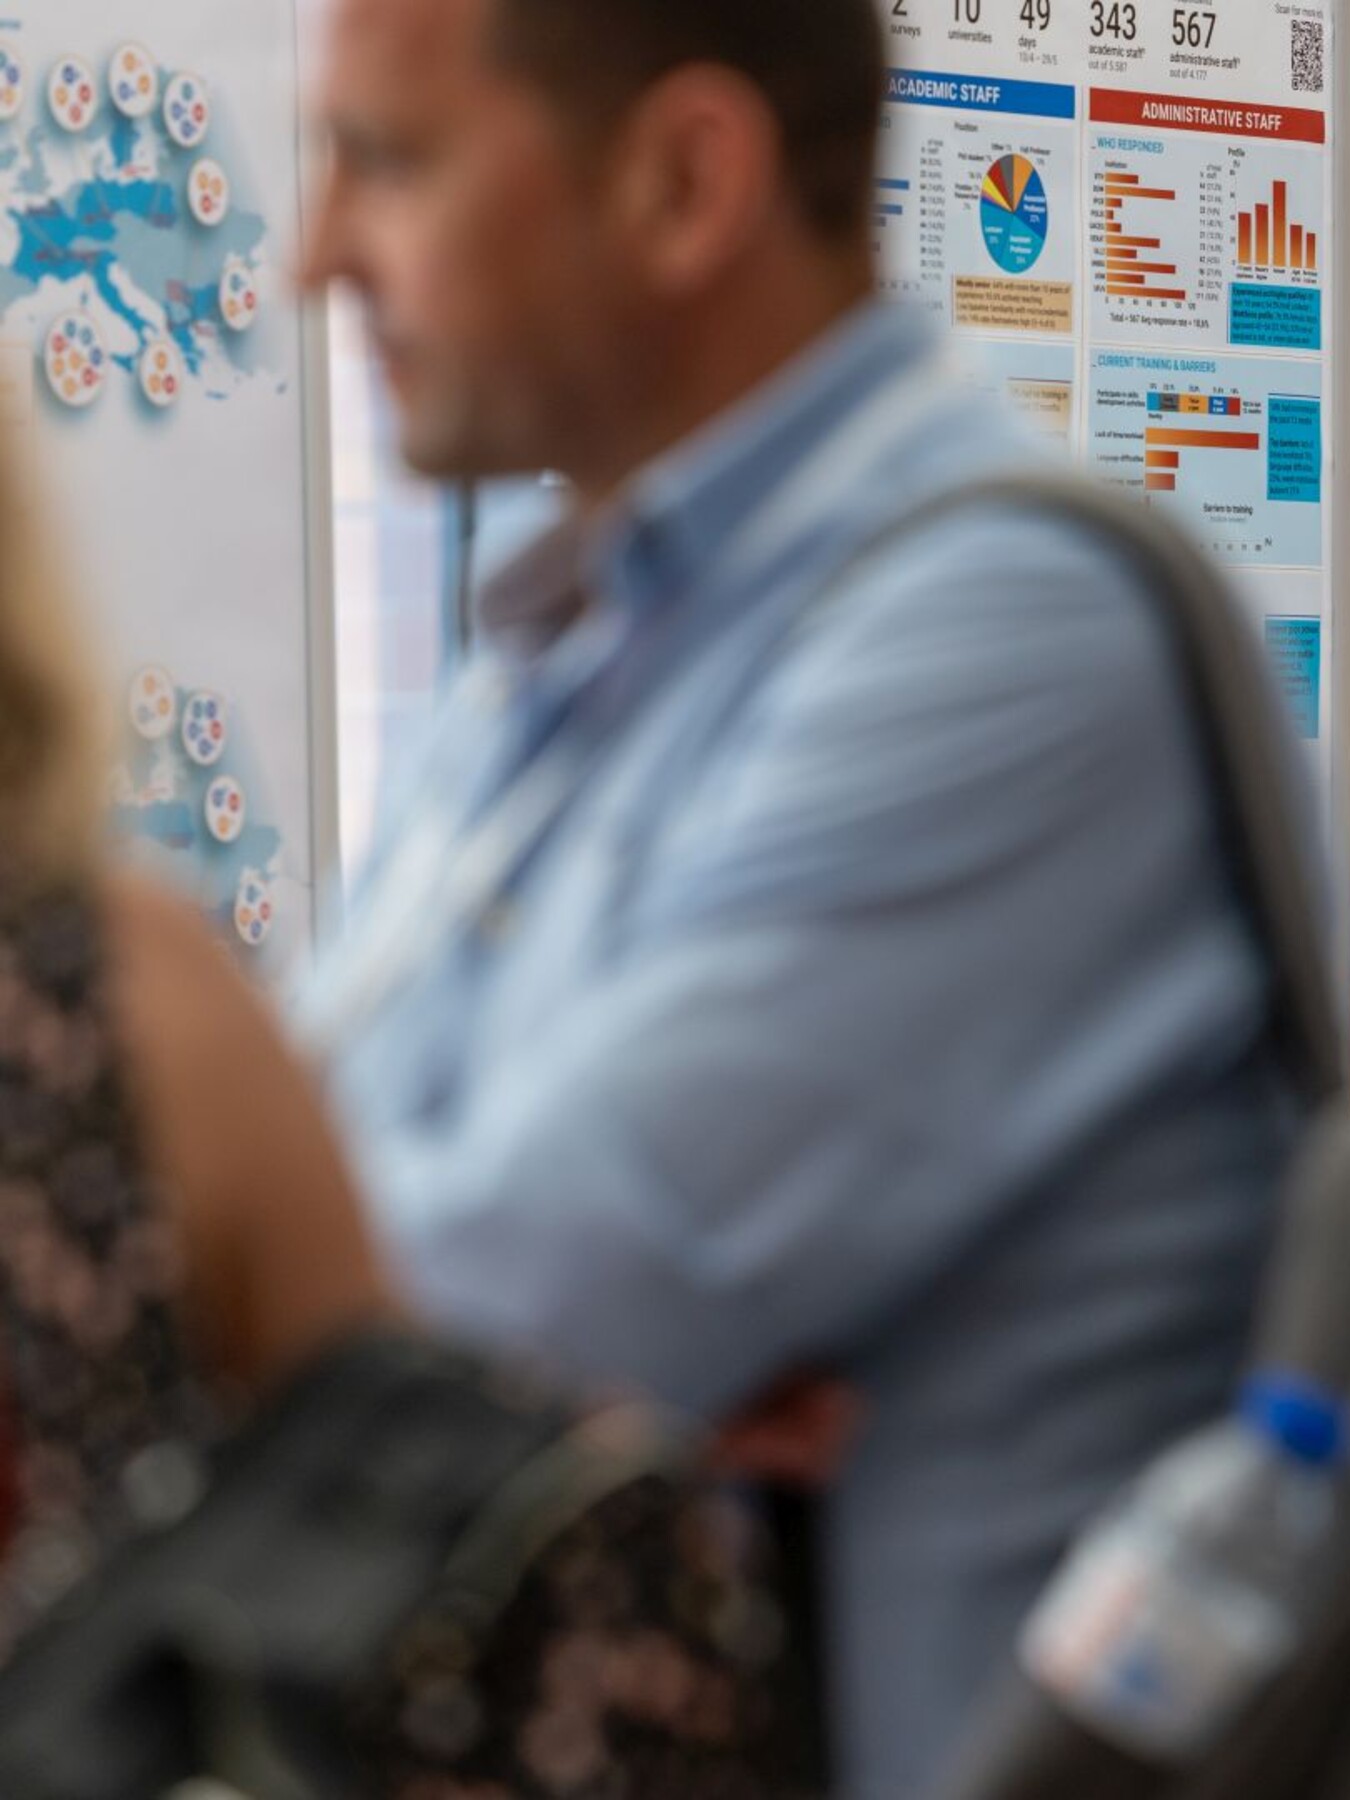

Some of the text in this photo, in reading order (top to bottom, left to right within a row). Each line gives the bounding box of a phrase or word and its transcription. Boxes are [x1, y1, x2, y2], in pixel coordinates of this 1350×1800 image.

[1019, 0, 1051, 31] 49
[1090, 0, 1137, 40] 343
[890, 24, 921, 39] surveys
[947, 29, 993, 44] universities
[1171, 9, 1216, 49] 567
[1018, 35, 1037, 49] days
[1088, 44, 1125, 58] academic
[1169, 52, 1220, 68] administrative
[888, 78, 1001, 104] ACADEMIC STAFF
[1141, 102, 1282, 131] ADMINISTRATIVE STAFF
[1097, 137, 1165, 154] WHO RESPONDED
[1098, 354, 1216, 373] CURRENT TRAINING & BARRIERS
